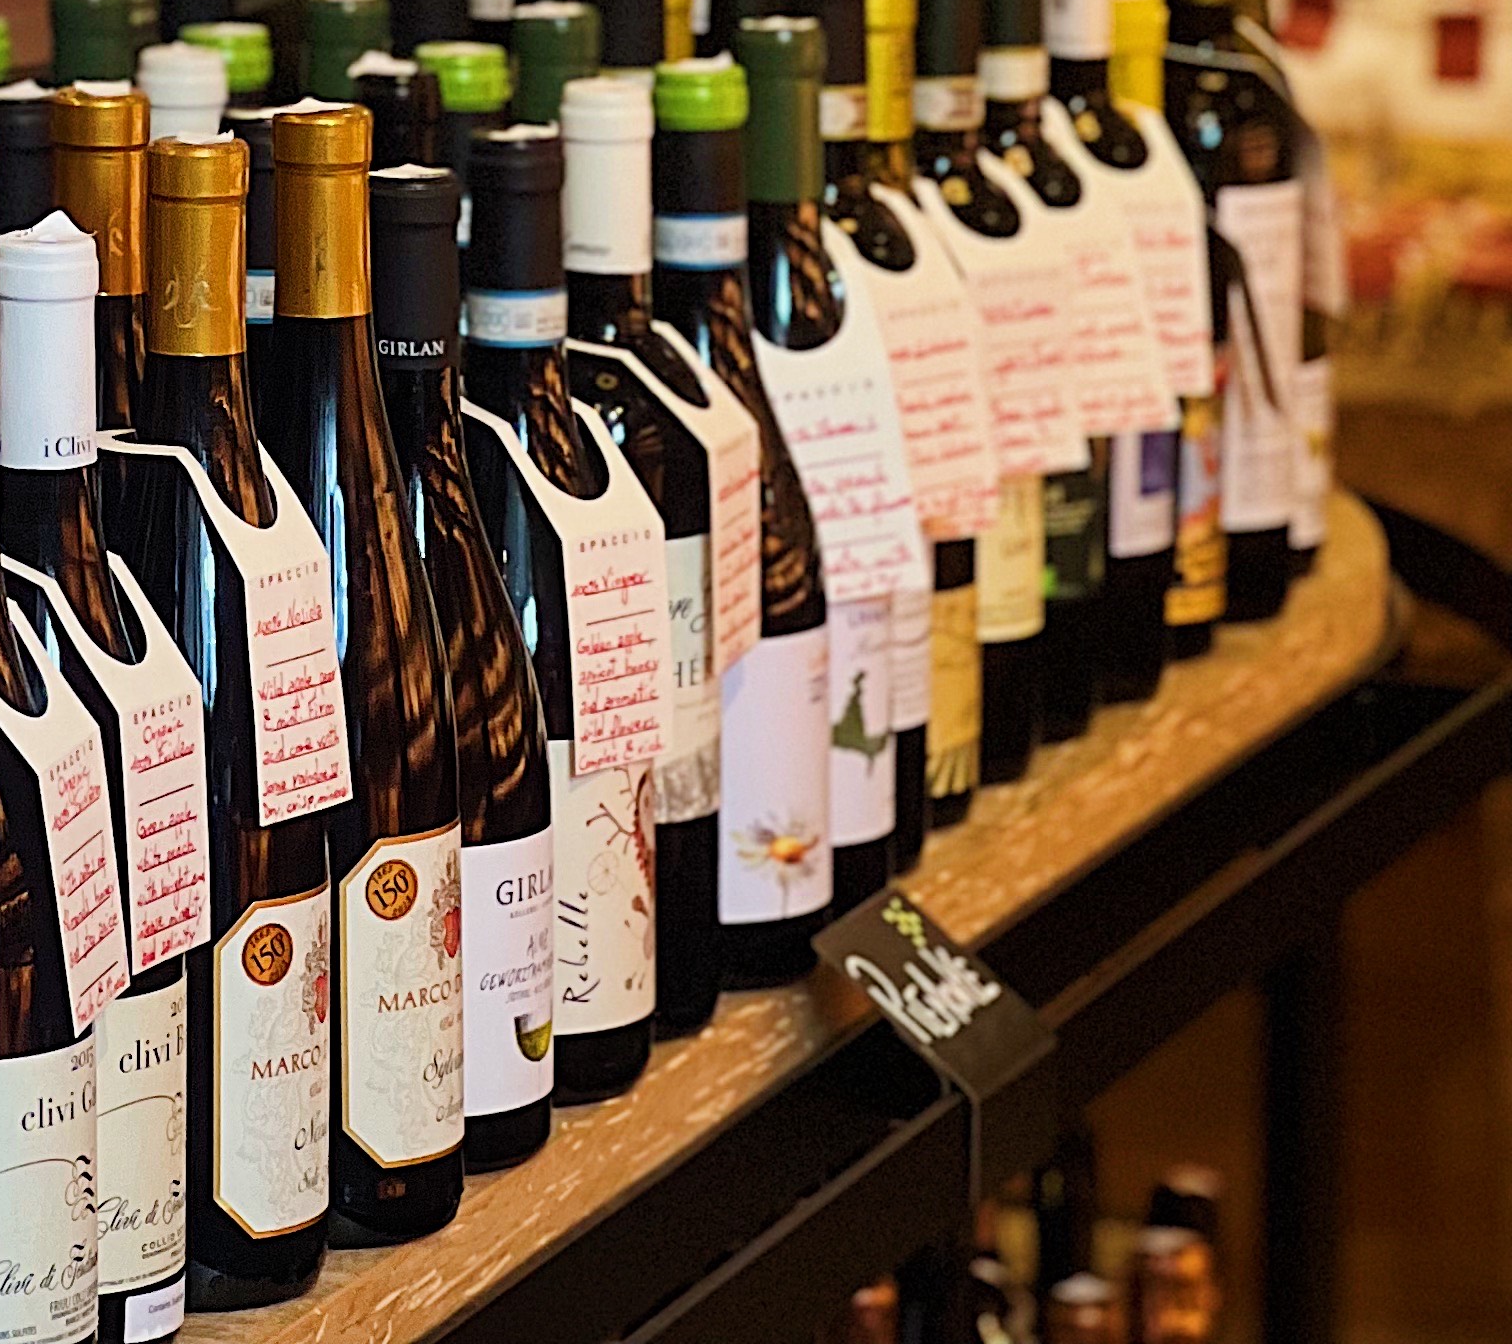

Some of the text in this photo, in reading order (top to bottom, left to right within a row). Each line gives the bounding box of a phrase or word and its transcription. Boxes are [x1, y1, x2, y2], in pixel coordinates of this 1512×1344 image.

[378, 338, 445, 358] GIRLAN
[54, 434, 92, 458] Clivi
[260, 561, 319, 589] SPACCIO
[133, 693, 192, 726] SPACCIO
[378, 979, 452, 1014] MARCO
[119, 1033, 171, 1074] clivi
[251, 1046, 321, 1081] MARCO
[21, 1091, 76, 1132] clivi
